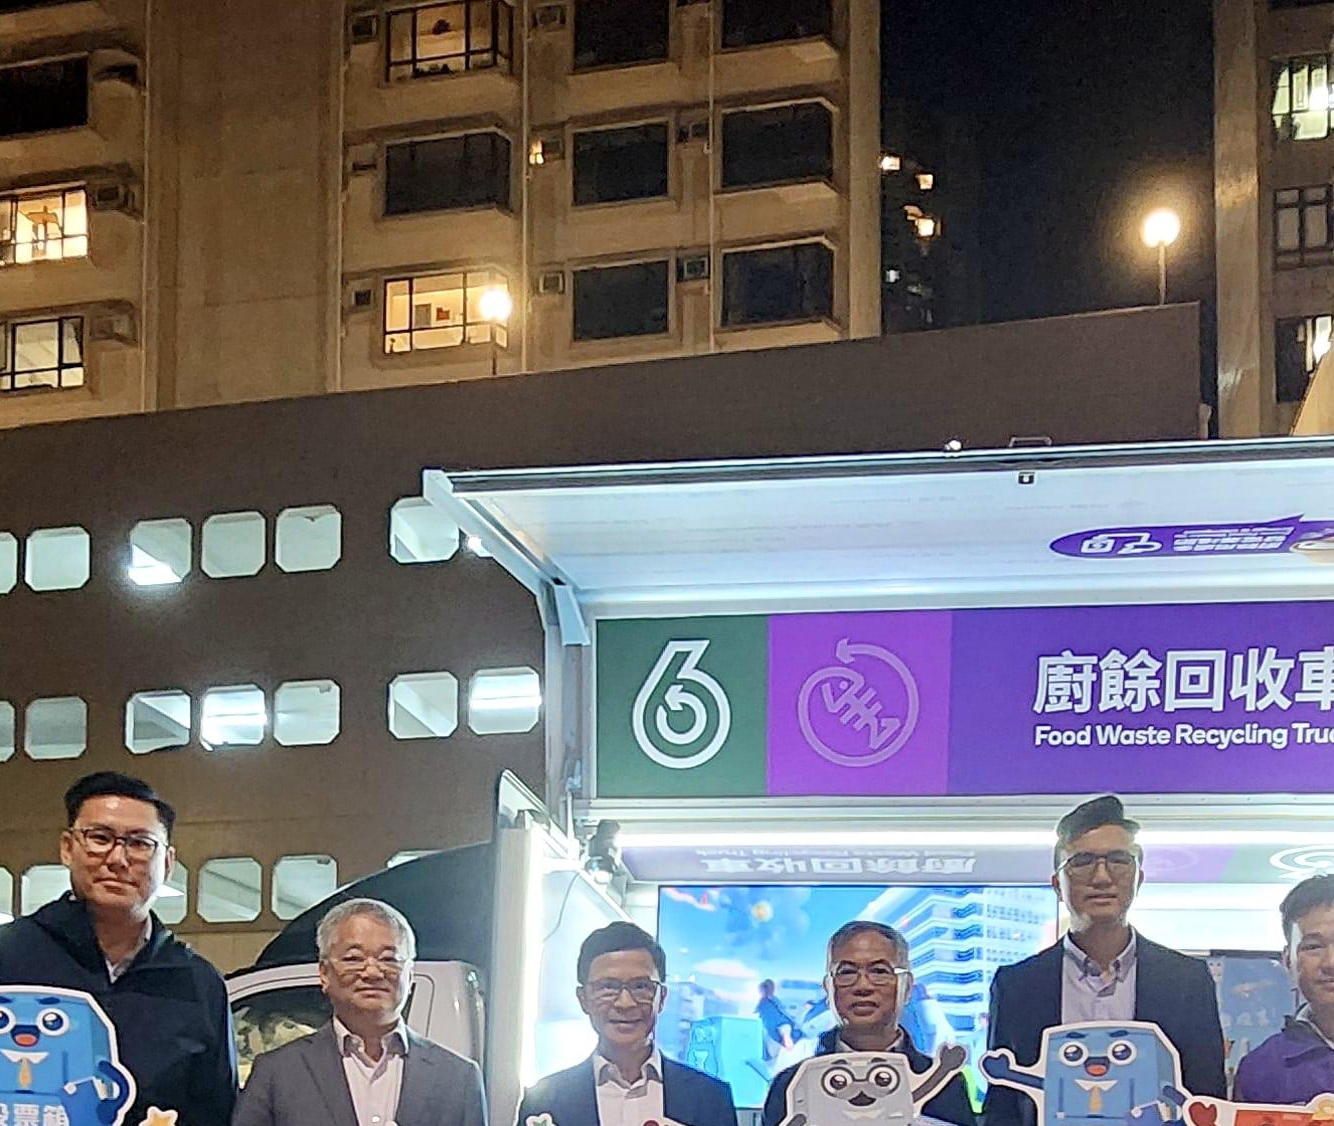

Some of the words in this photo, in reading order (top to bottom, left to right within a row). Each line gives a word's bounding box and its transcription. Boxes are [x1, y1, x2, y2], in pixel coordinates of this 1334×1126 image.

[1034, 724, 1091, 746] Food
[1095, 724, 1171, 746] Waste
[1175, 722, 1289, 750] Recycling
